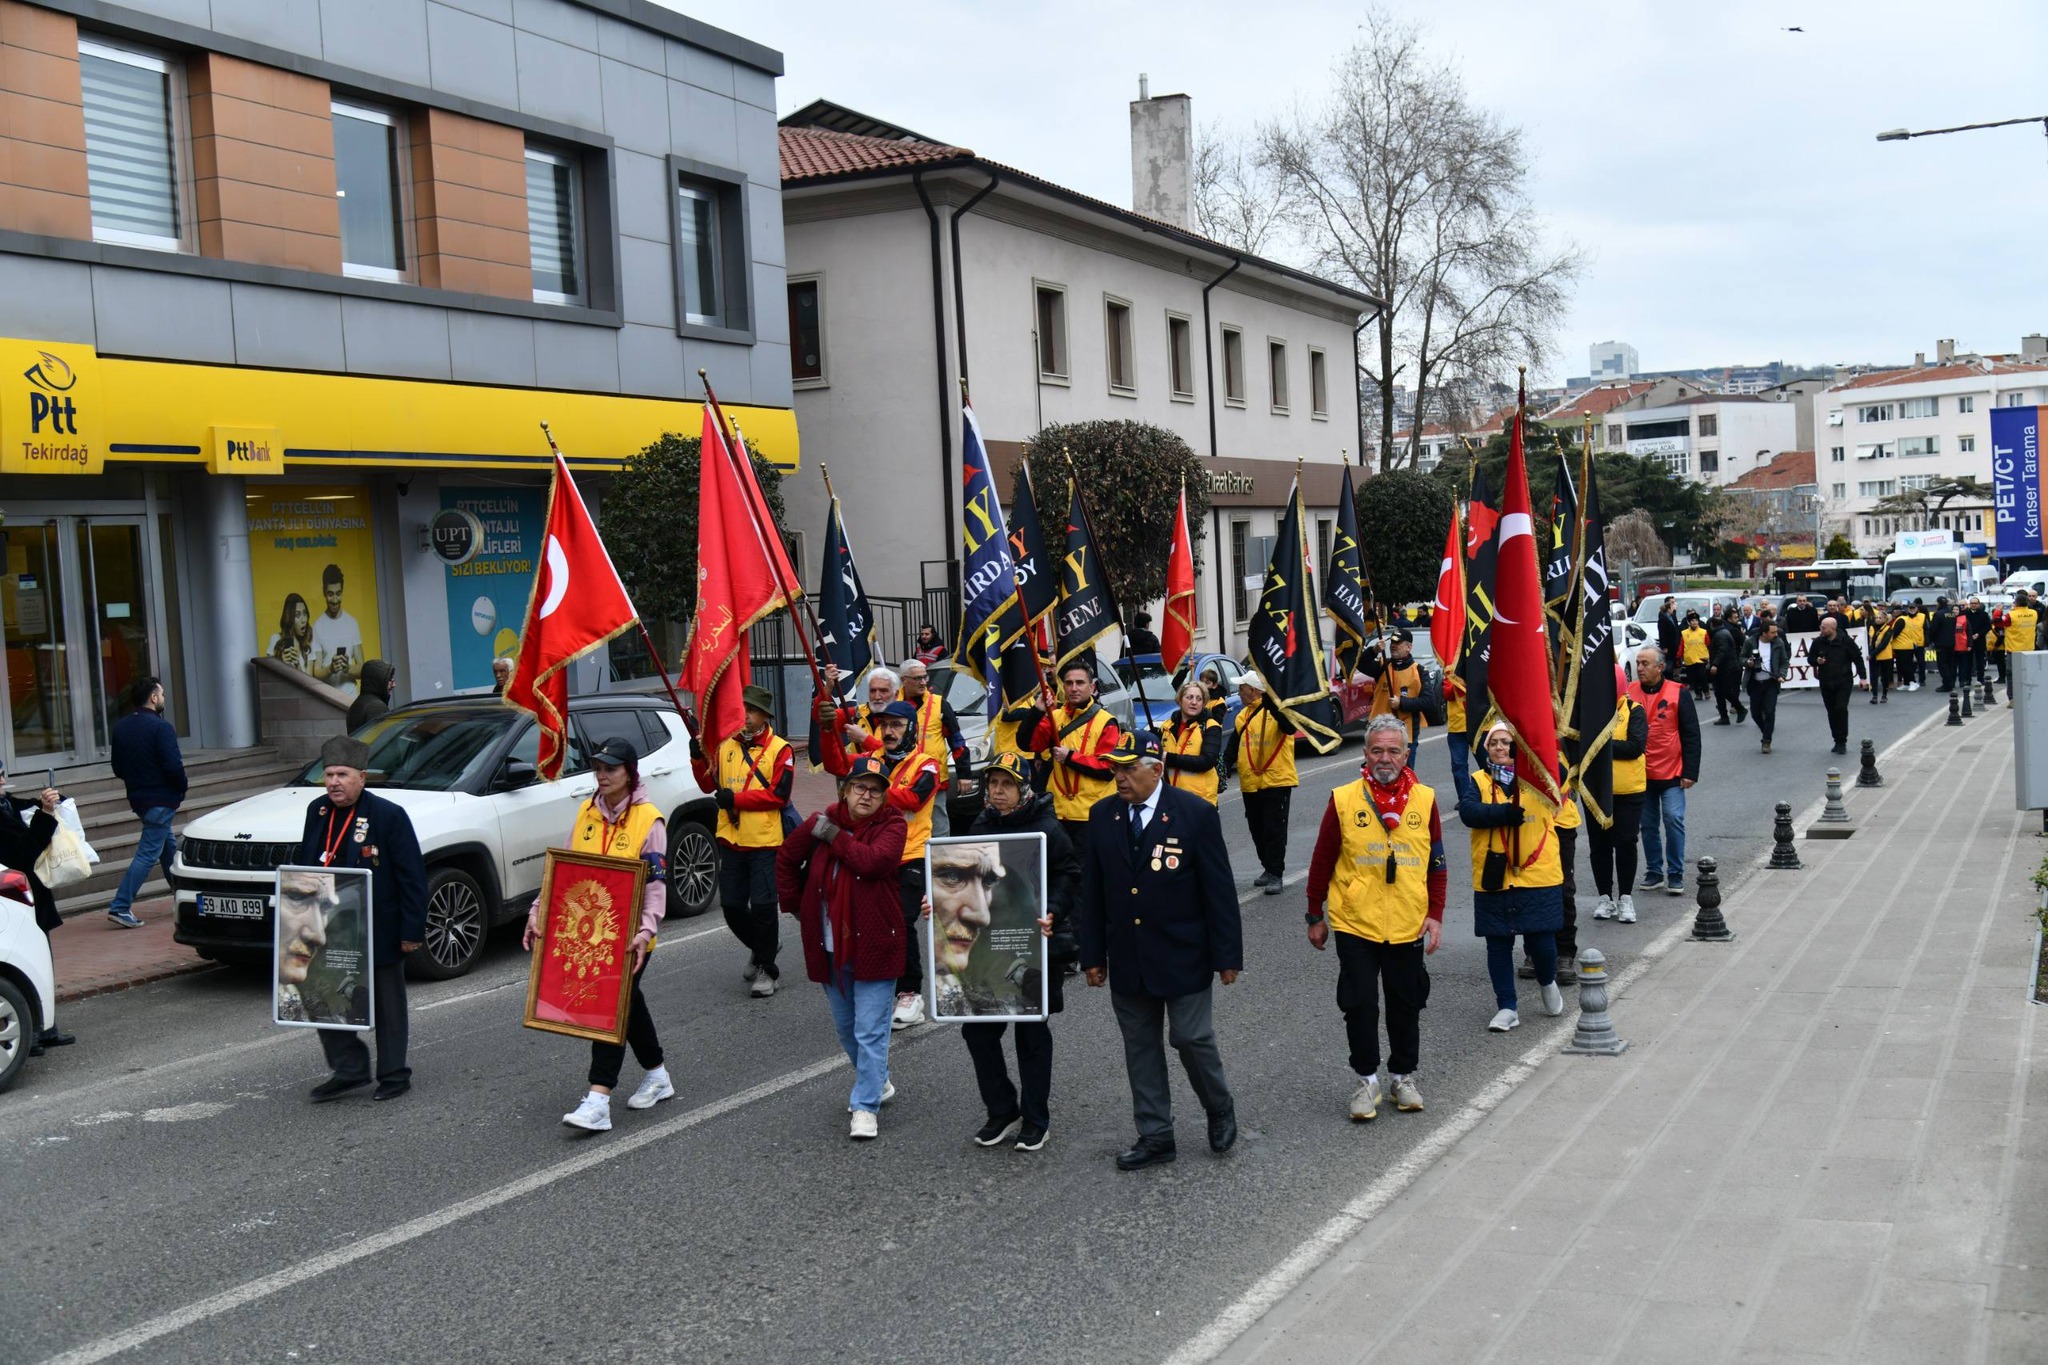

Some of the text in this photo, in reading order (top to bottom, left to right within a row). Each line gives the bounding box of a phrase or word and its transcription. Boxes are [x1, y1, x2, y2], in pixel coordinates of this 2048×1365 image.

[30, 391, 78, 435] Ptt
[22, 442, 88, 466] Tekirdağ
[1994, 444, 2016, 523] PET/CT
[2022, 425, 2038, 538] Kanser Tarama
[435, 527, 469, 542] UPT
[234, 832, 252, 840] Jeep
[204, 897, 261, 915] 59 AKD 899
